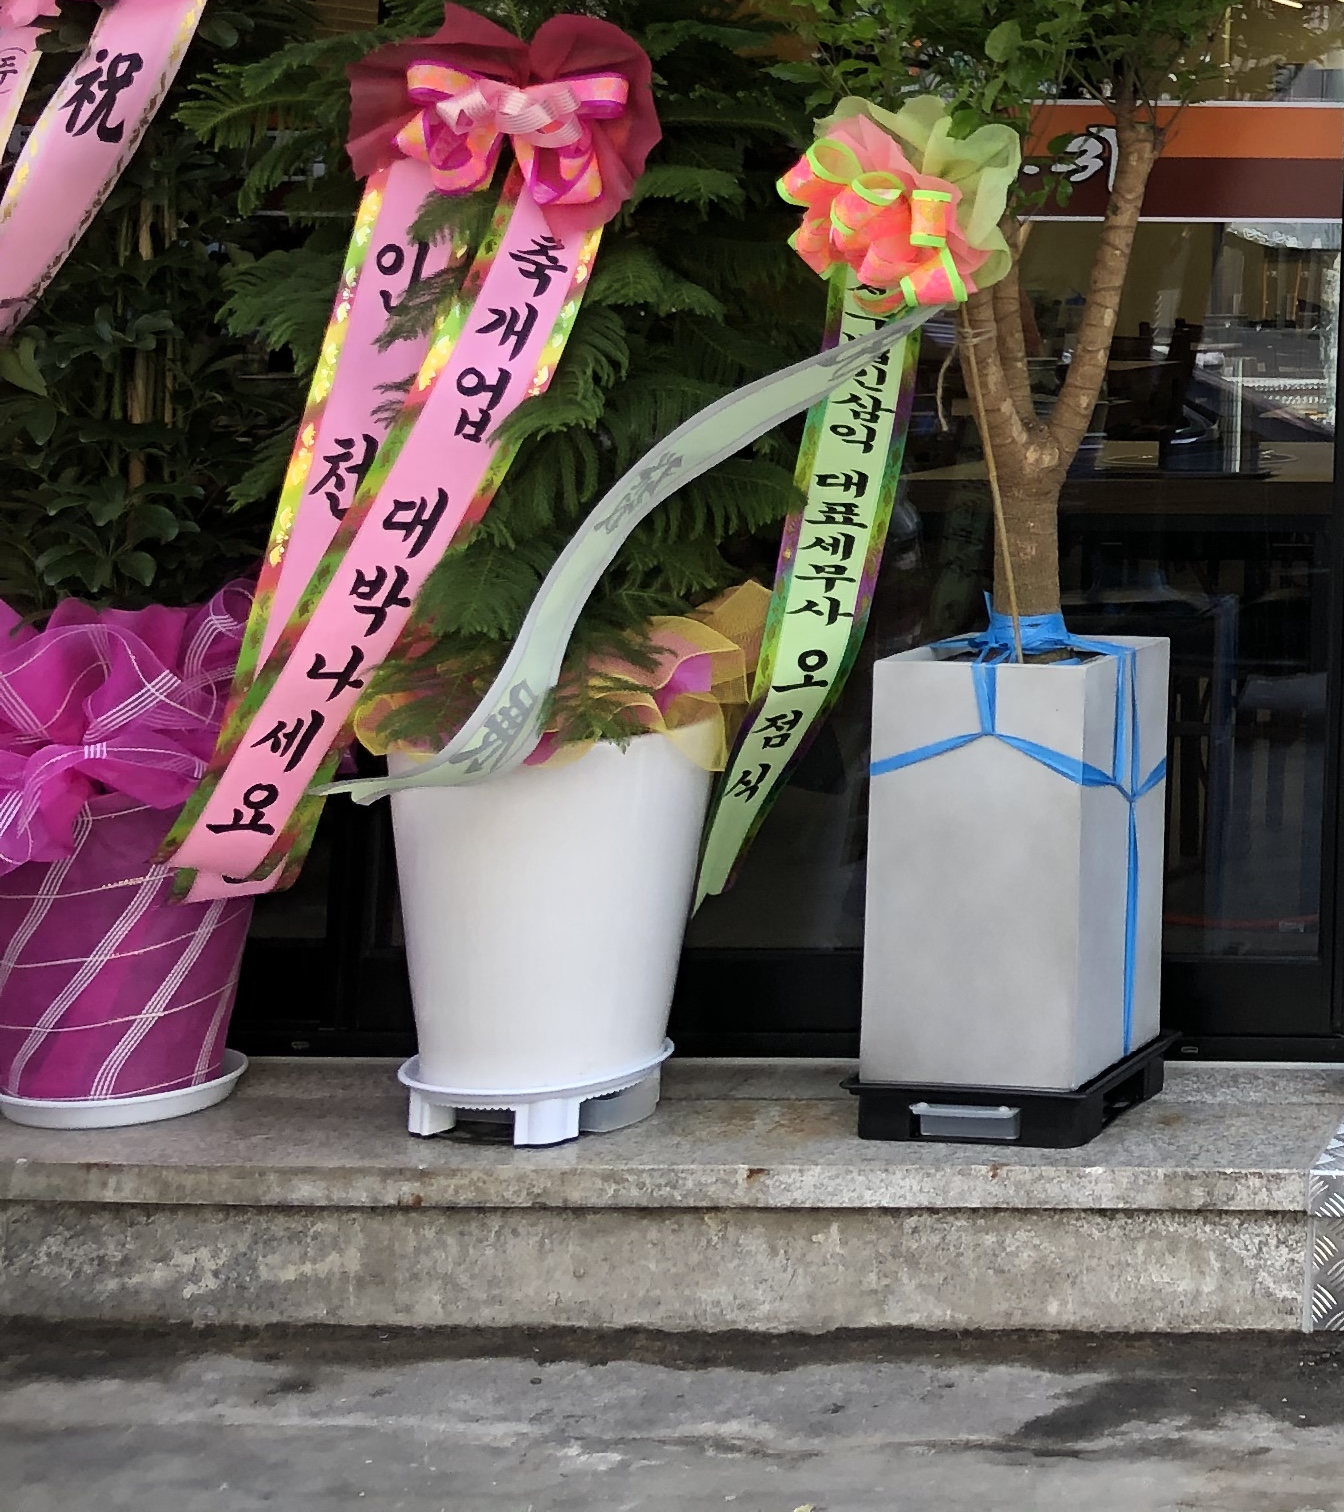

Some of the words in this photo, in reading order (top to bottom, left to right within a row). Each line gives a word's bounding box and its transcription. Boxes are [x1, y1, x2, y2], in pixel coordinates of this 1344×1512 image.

[58, 49, 144, 143] 祝
[454, 235, 569, 443] 축개업
[786, 469, 870, 628] 대표세무사
[206, 487, 449, 837] 대박나세요
